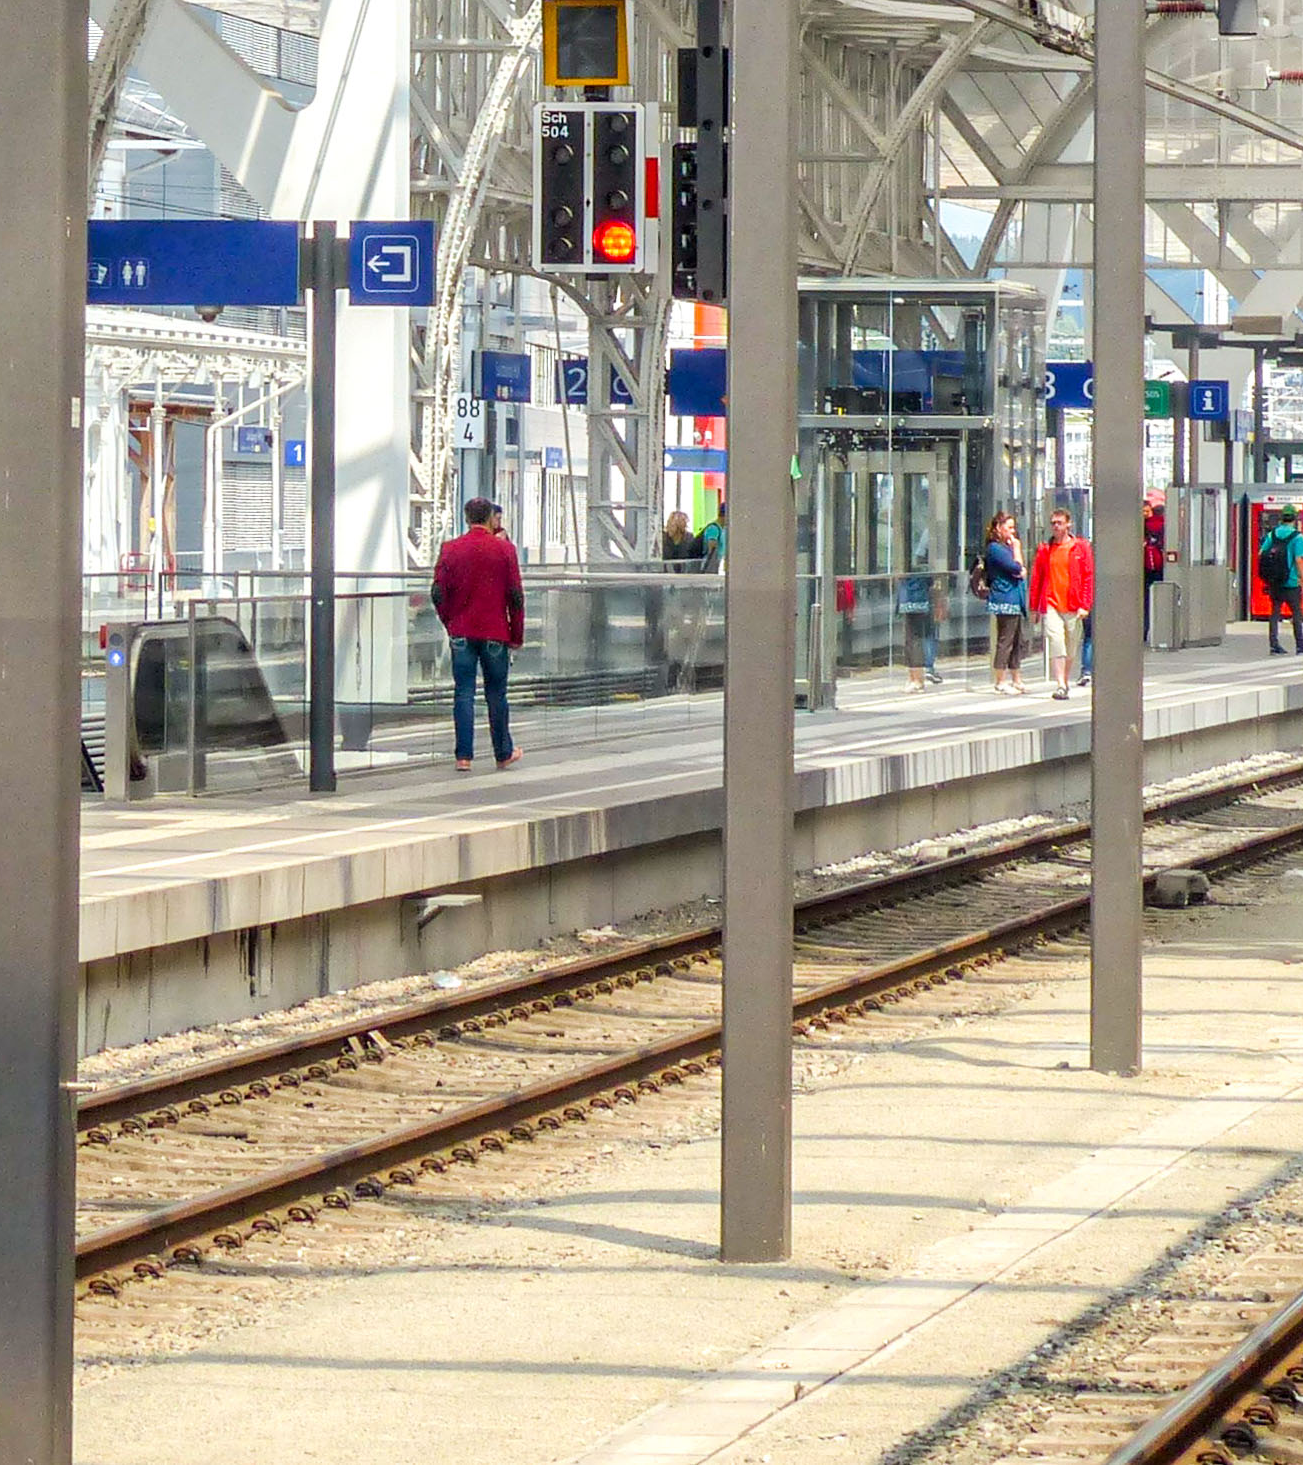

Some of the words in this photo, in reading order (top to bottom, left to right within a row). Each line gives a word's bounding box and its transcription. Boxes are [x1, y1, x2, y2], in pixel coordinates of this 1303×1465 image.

[542, 111, 567, 124] Sch
[542, 125, 569, 138] 504
[567, 367, 587, 396] 2
[457, 398, 480, 418] 88
[463, 422, 474, 443] 4
[293, 444, 303, 462] 1
